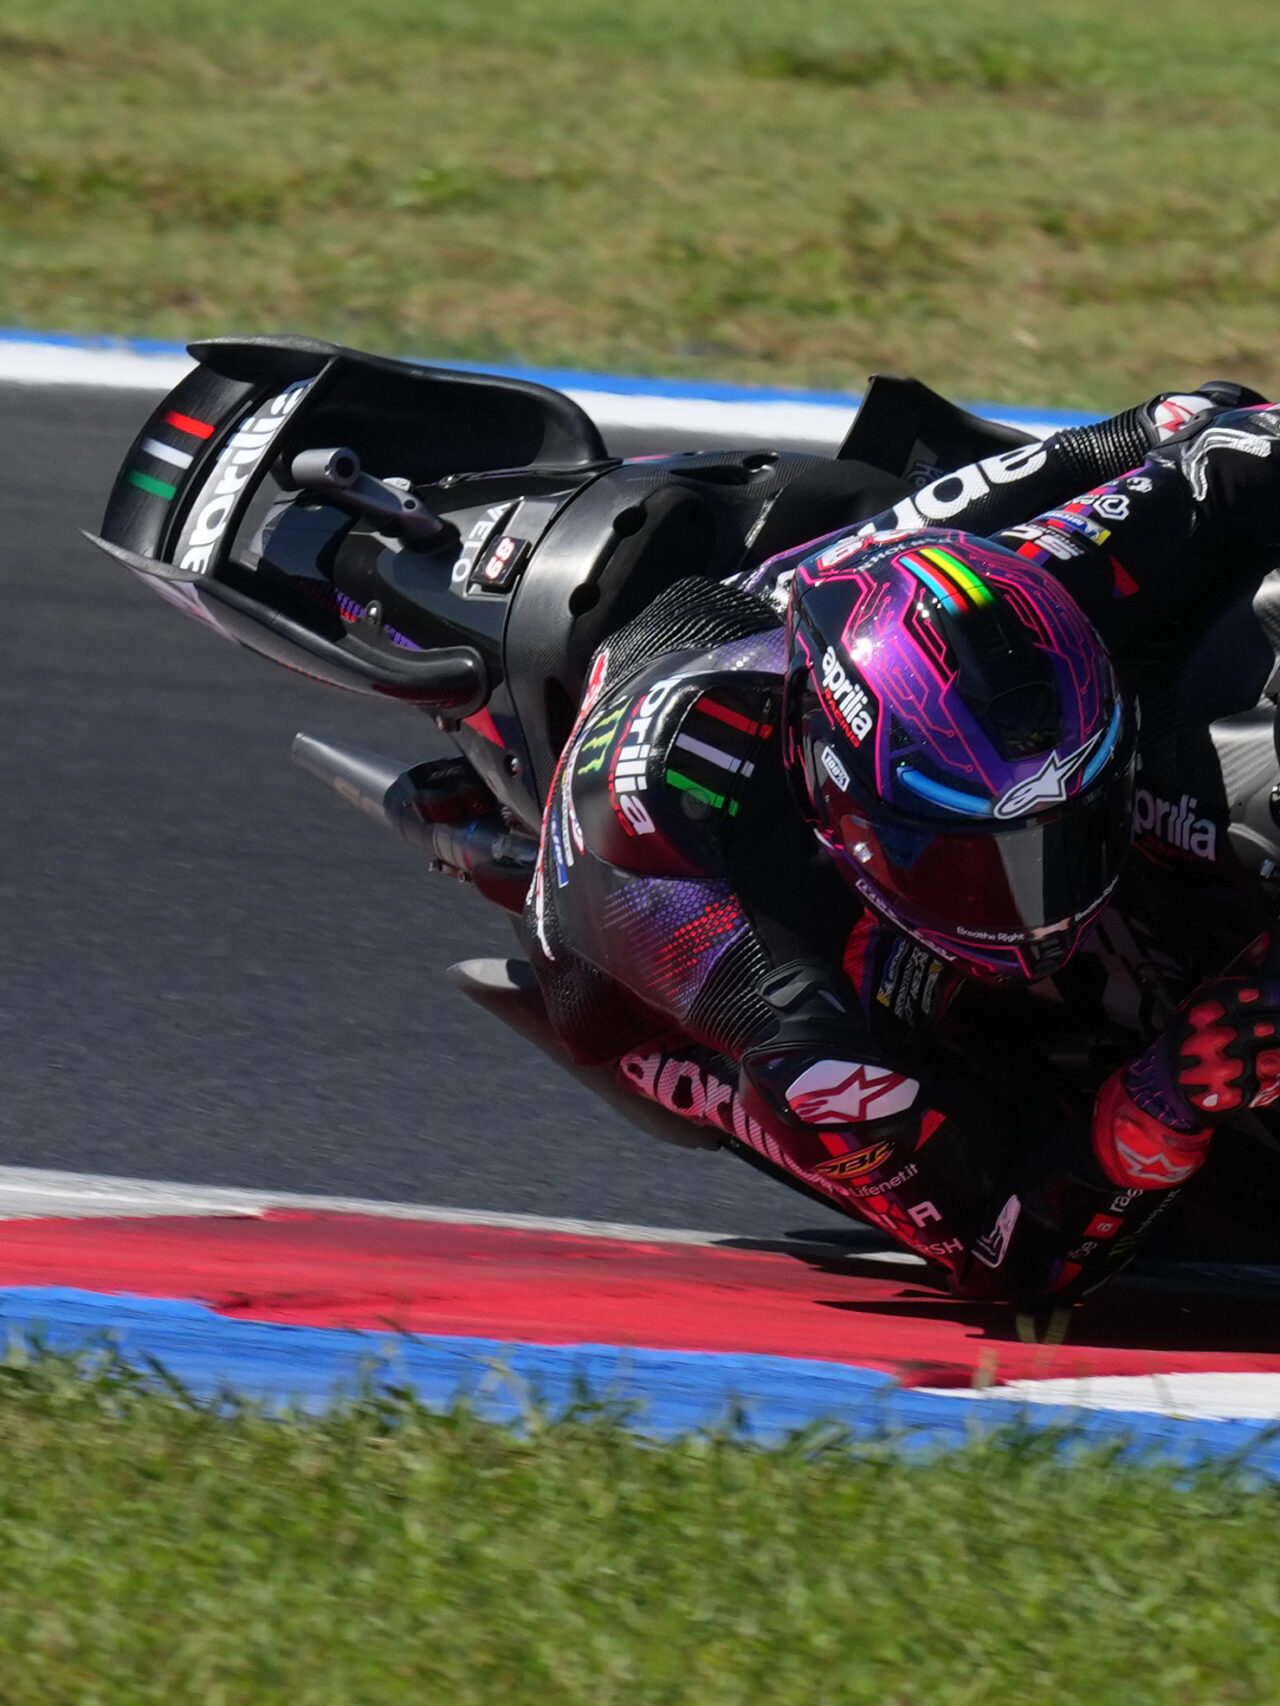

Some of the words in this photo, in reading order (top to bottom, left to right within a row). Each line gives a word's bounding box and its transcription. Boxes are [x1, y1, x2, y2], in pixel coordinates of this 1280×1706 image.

[821, 646, 874, 742] aprilia
[825, 752, 848, 790] 100%
[956, 925, 996, 941] Breathe
[997, 930, 1025, 943] Right
